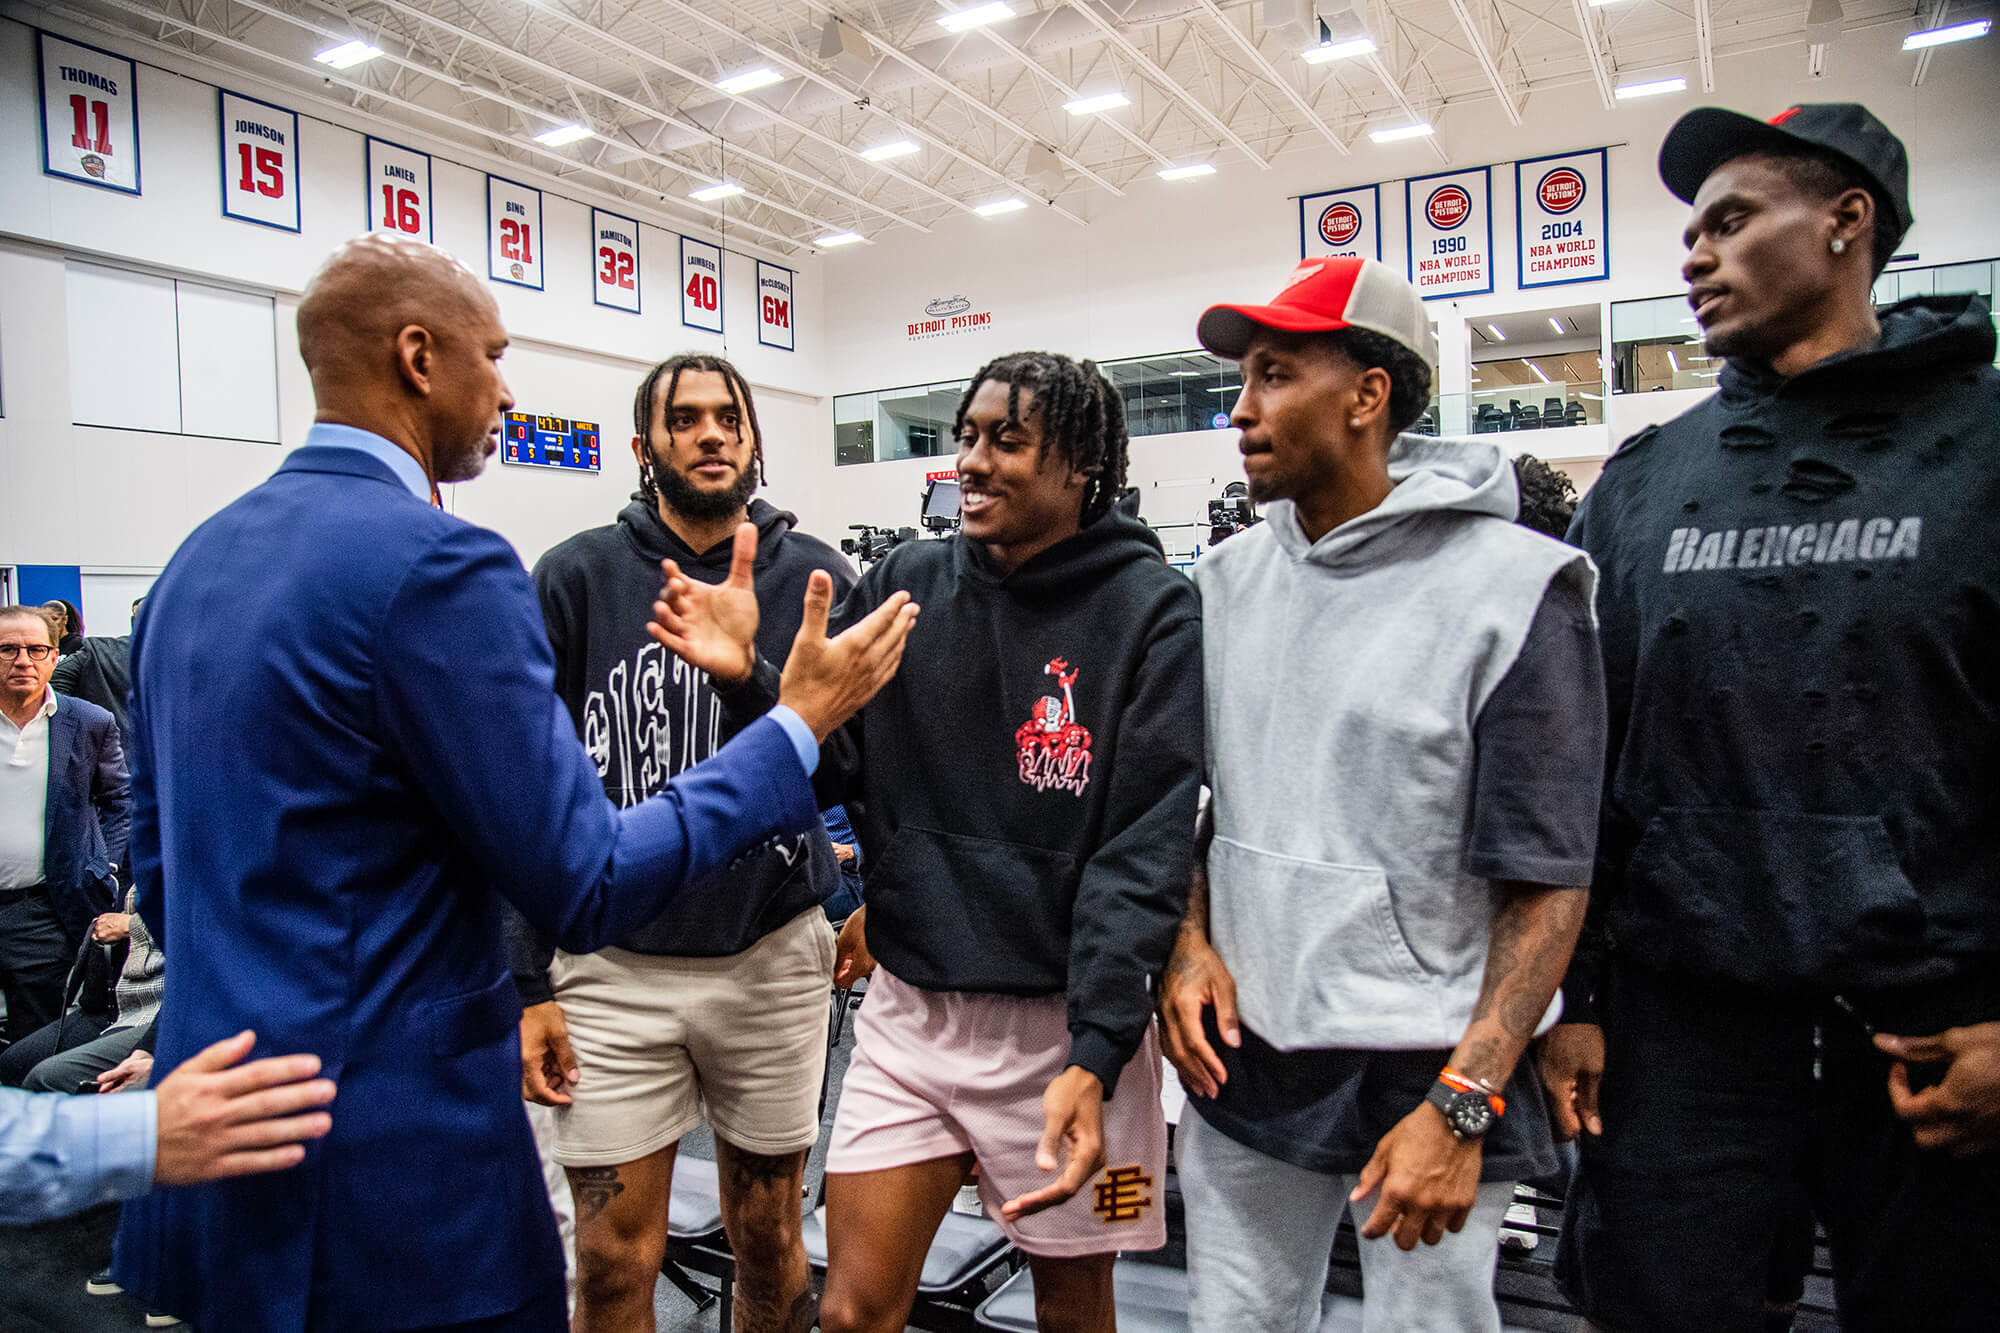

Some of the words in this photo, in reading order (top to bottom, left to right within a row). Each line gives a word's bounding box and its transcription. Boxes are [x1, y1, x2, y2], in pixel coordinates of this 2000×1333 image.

[59, 66, 118, 96] THOMAS
[69, 94, 113, 156] 11
[235, 119, 285, 146] JOHNSON
[238, 143, 284, 199] 15
[384, 164, 416, 184] LANIER
[1546, 181, 1576, 193] DETROIT
[1546, 189, 1577, 201] PISTONS
[382, 184, 420, 234] 16
[506, 201, 525, 216] BING
[1434, 198, 1462, 209] DETROIT
[1434, 206, 1463, 217] PISTONS
[1326, 215, 1353, 226] DETROIT
[1326, 223, 1354, 233] PISTONS
[600, 230, 632, 248] HAMILTON
[1541, 220, 1583, 240] 2004
[500, 218, 532, 264] 21
[1432, 236, 1466, 255] 1990
[1530, 245, 1552, 257] NBA
[1556, 239, 1596, 253] WORLD
[599, 246, 635, 290] 32
[687, 255, 716, 273] LAIMBEER
[1419, 259, 1440, 271] NBA
[1444, 254, 1481, 268] WORLD
[1530, 254, 1595, 272] CHAMPIONS
[1420, 269, 1481, 286] CHAMPIONS
[686, 272, 717, 311] 40
[763, 295, 789, 328] GM
[907, 319, 946, 336] DETROIT
[952, 312, 991, 329] PISTONS
[517, 426, 526, 440] 0
[538, 417, 562, 431] 47.7
[557, 436, 563, 446] 3
[590, 435, 597, 448] 0
[511, 446, 518, 457] 0
[591, 455, 598, 465] 0
[1663, 516, 1924, 574] BALENCIAGA
